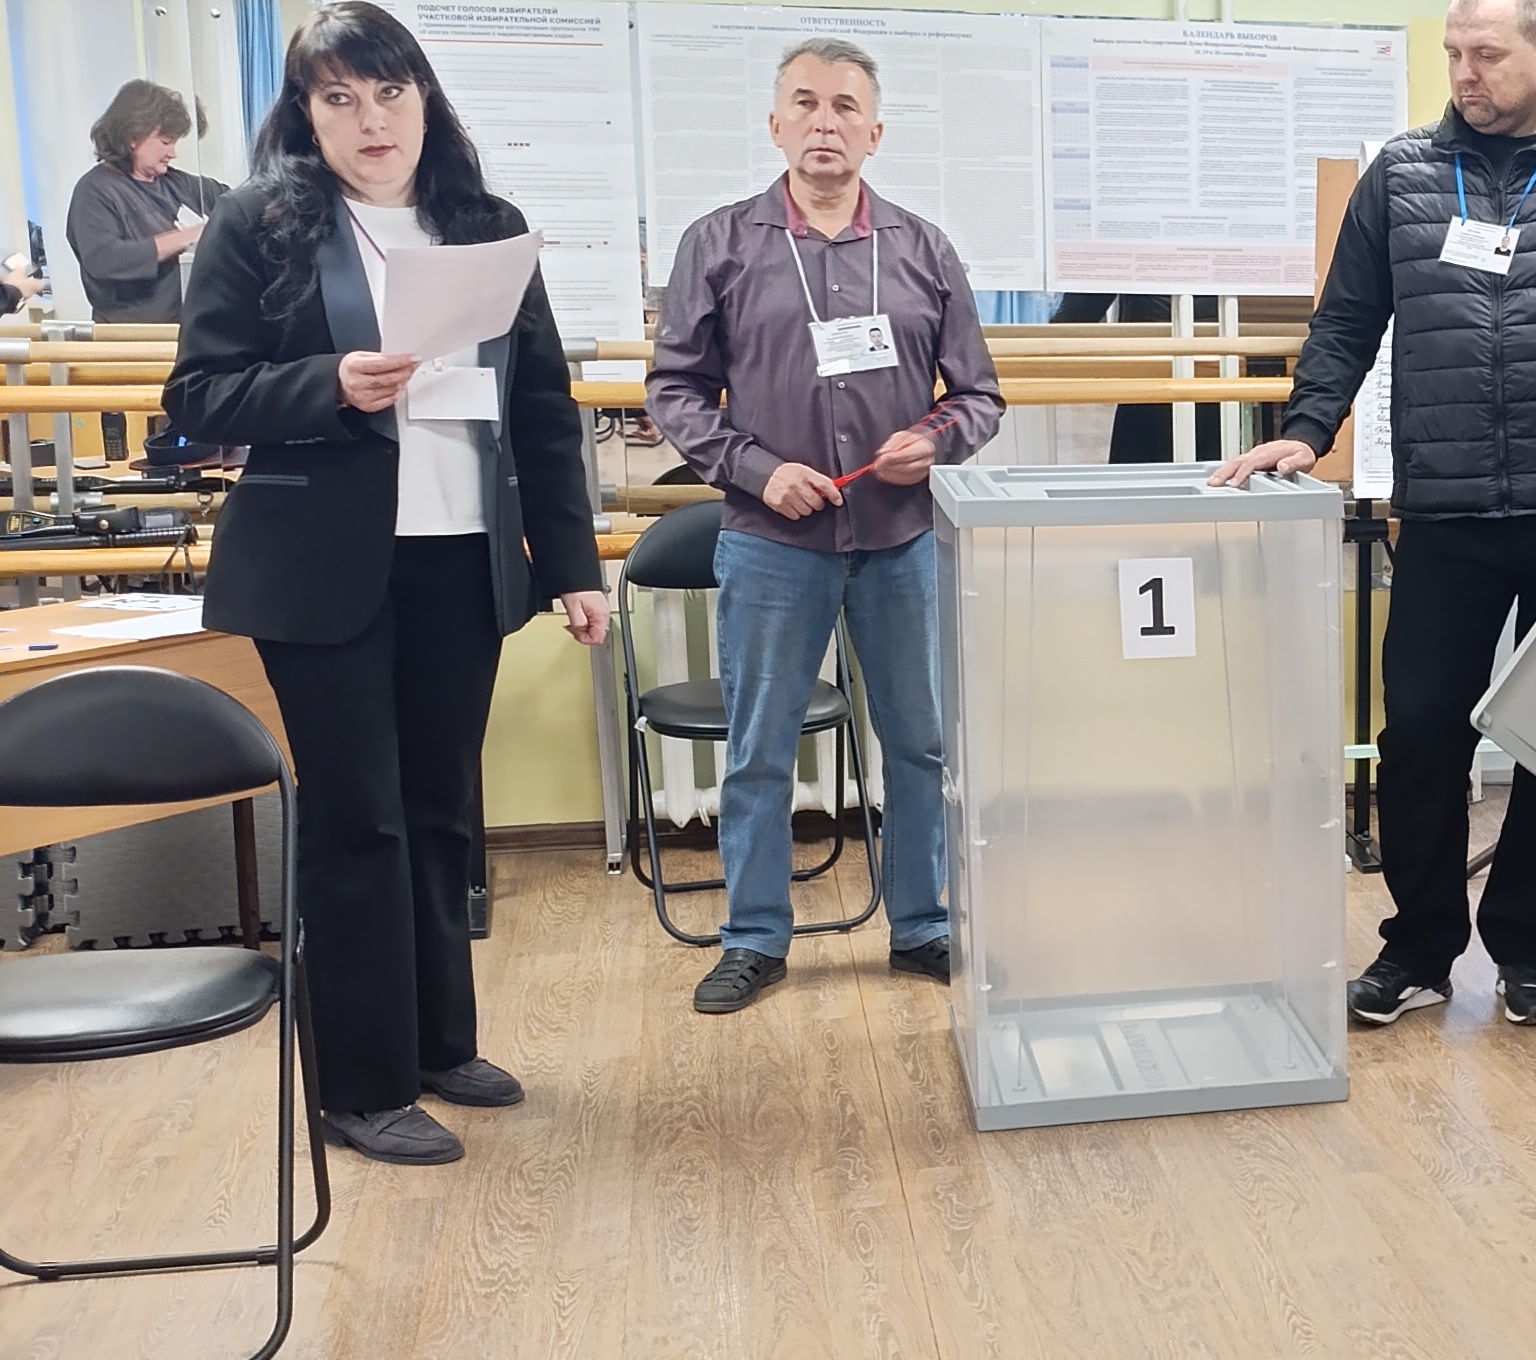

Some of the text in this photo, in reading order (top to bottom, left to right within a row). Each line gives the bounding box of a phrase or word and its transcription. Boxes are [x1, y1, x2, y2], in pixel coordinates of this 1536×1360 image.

[458, 5, 497, 13] ГОЛОСОВ
[499, 7, 558, 15] ИЗБИРАТЕЛЕЙ
[418, 13, 601, 25] УЧАСТКОВОЙ ИЗБИРАТЕЛЬНОЙ КОМИССИЕЙ
[800, 17, 886, 27] ОТВЕТСТВЕННОСТЬ
[1182, 30, 1278, 41] КАЛЕНДАРЬ ВЫБОРОВ
[1138, 577, 1176, 636] 1
